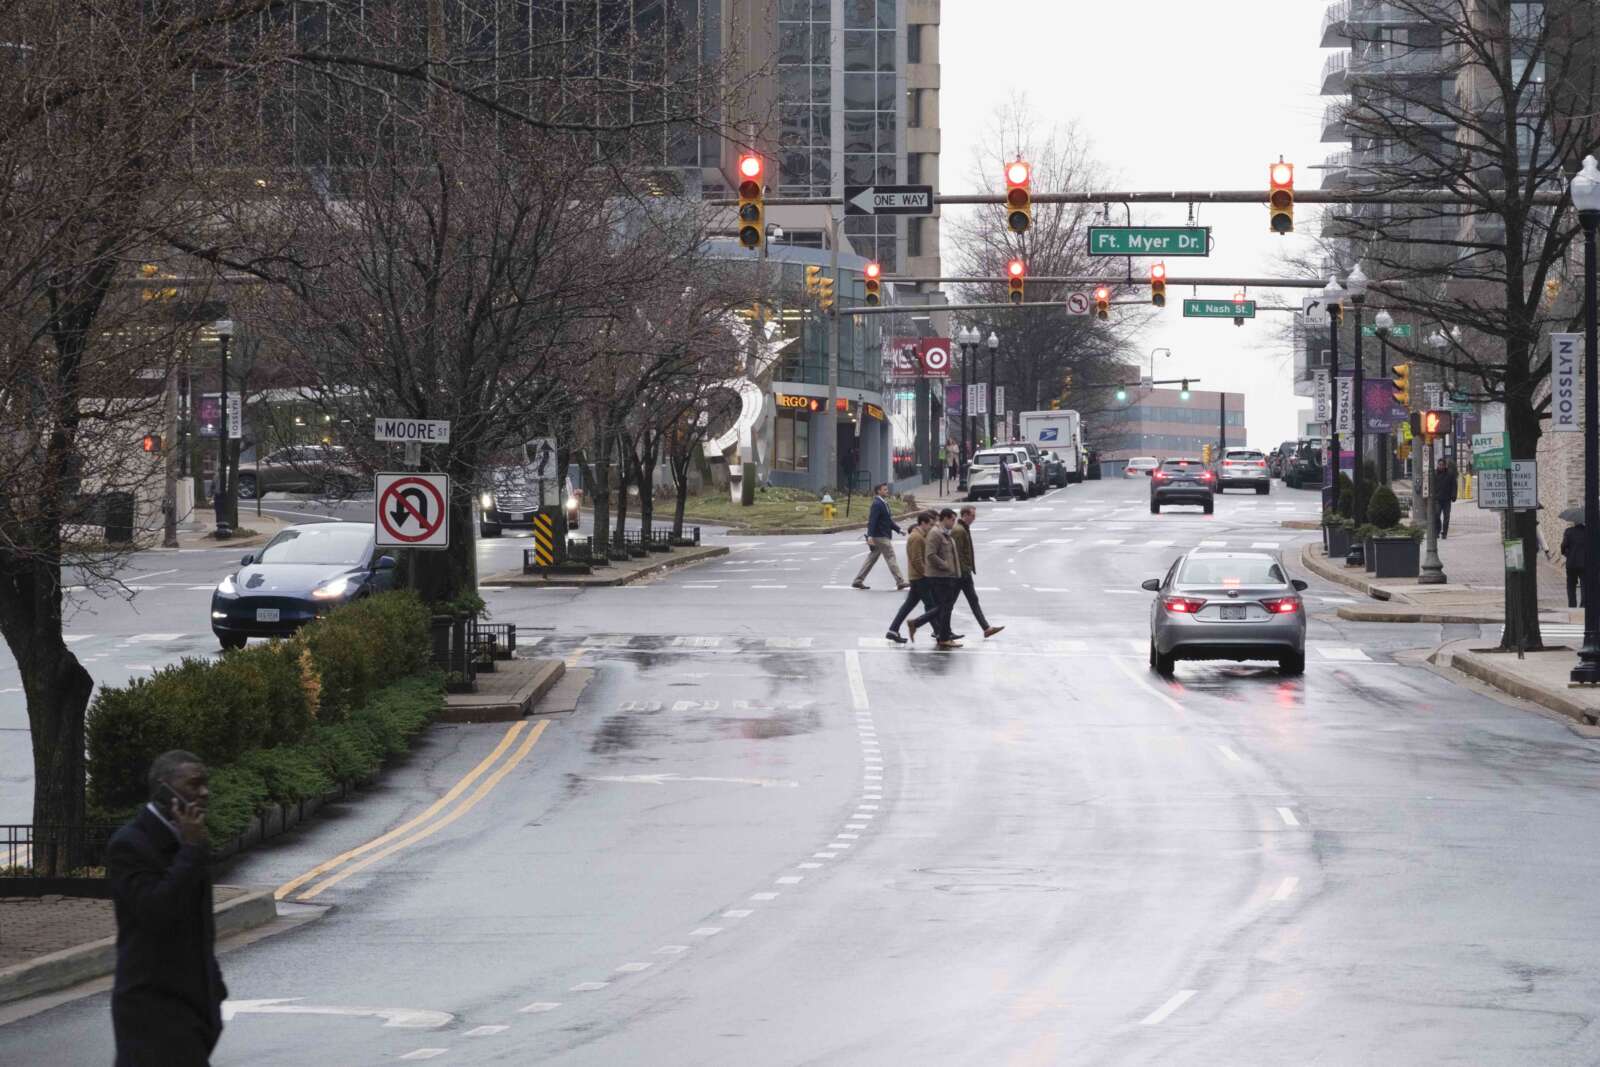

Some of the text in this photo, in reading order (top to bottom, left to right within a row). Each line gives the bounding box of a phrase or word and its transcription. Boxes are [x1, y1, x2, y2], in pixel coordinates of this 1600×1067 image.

[874, 194, 925, 206] ONE WAY
[1098, 234, 1200, 251] Ft. Myer Dr.
[1191, 304, 1248, 314] N. Nash St.
[1559, 341, 1573, 425] ROSSLYN
[1317, 373, 1326, 418] ROSSLYN
[1340, 381, 1349, 430] ROSSLYN
[377, 421, 447, 440] N MOORE ST
[1474, 437, 1492, 446] ART
